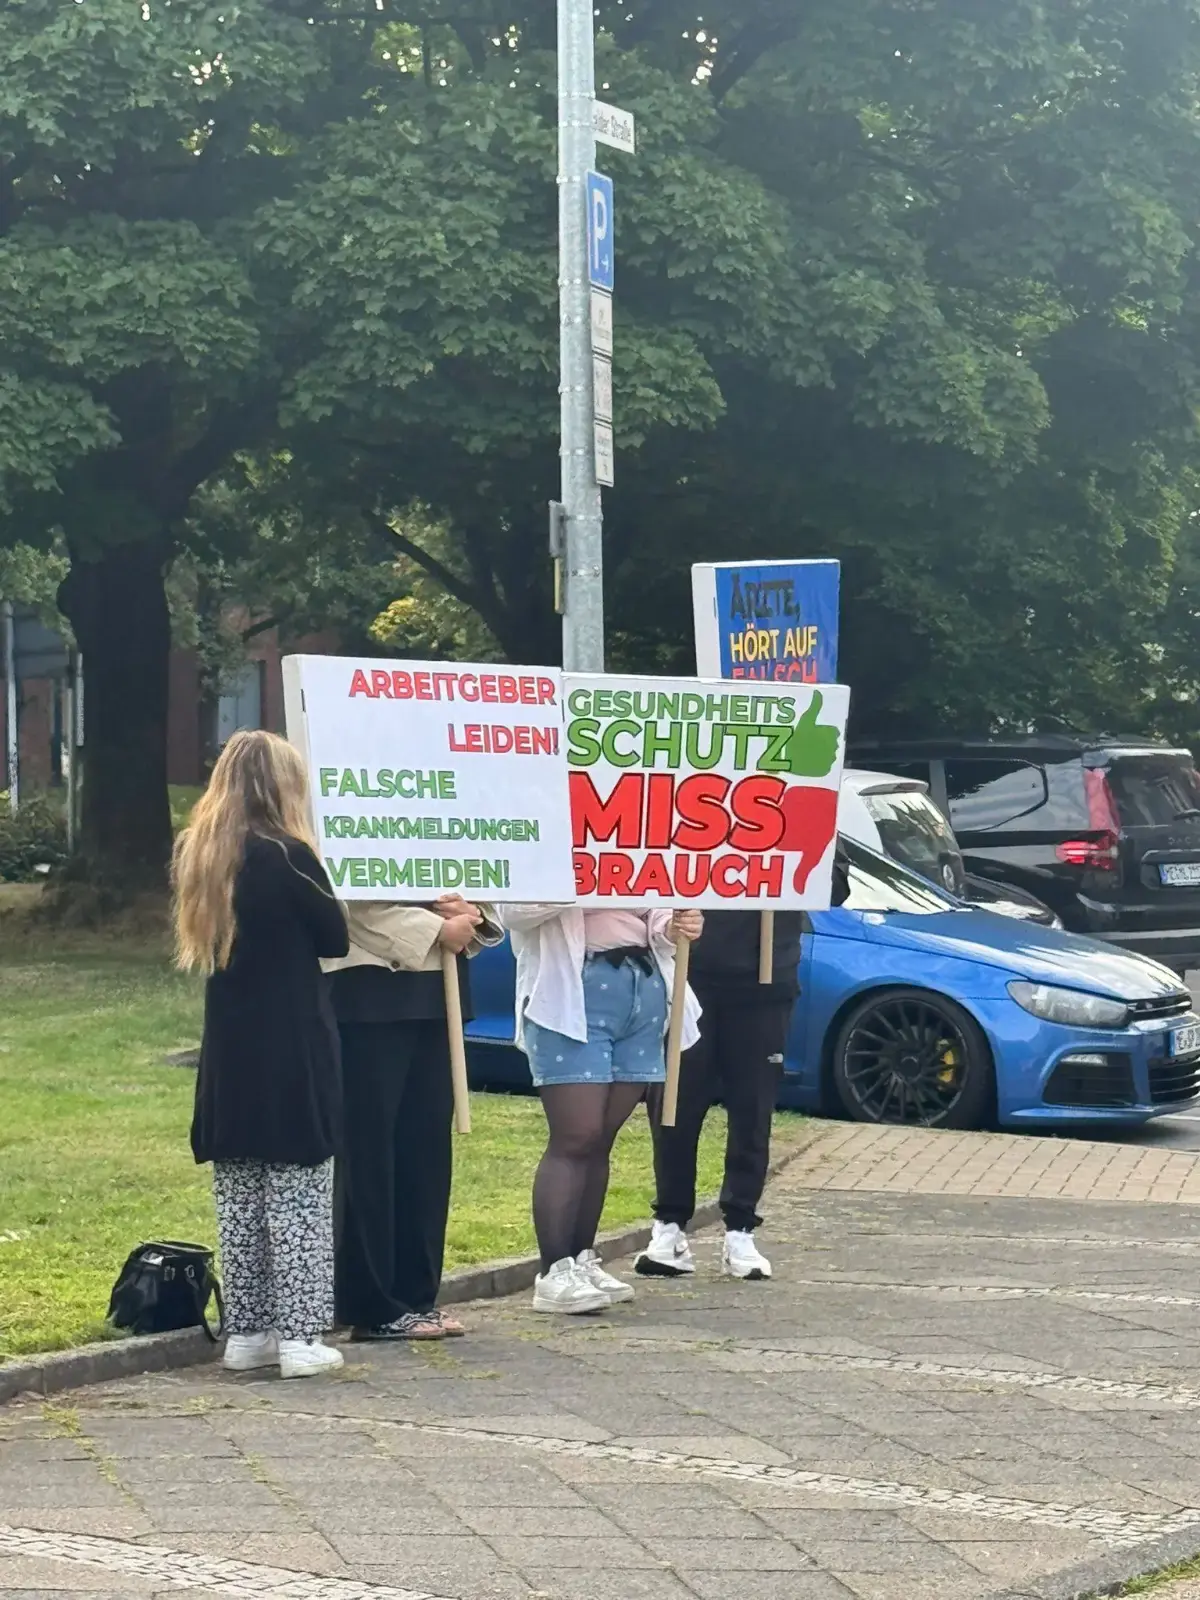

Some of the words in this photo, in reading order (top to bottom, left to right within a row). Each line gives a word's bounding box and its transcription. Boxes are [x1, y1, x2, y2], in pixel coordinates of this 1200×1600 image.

[729, 622, 780, 663] HÖRT
[783, 626, 818, 659] AUF
[349, 669, 557, 705] ARBEITGEBER
[568, 689, 796, 724] GESUNDHEITS
[448, 723, 560, 755] LEIDEN!
[567, 718, 795, 771] SCHUTZ
[320, 768, 457, 799] FALSCHE
[323, 816, 540, 842] KRANKMELDUNGEN
[568, 771, 787, 852] MISS
[325, 857, 511, 888] VERMEIDEN!
[574, 852, 784, 898] BRAUCH
